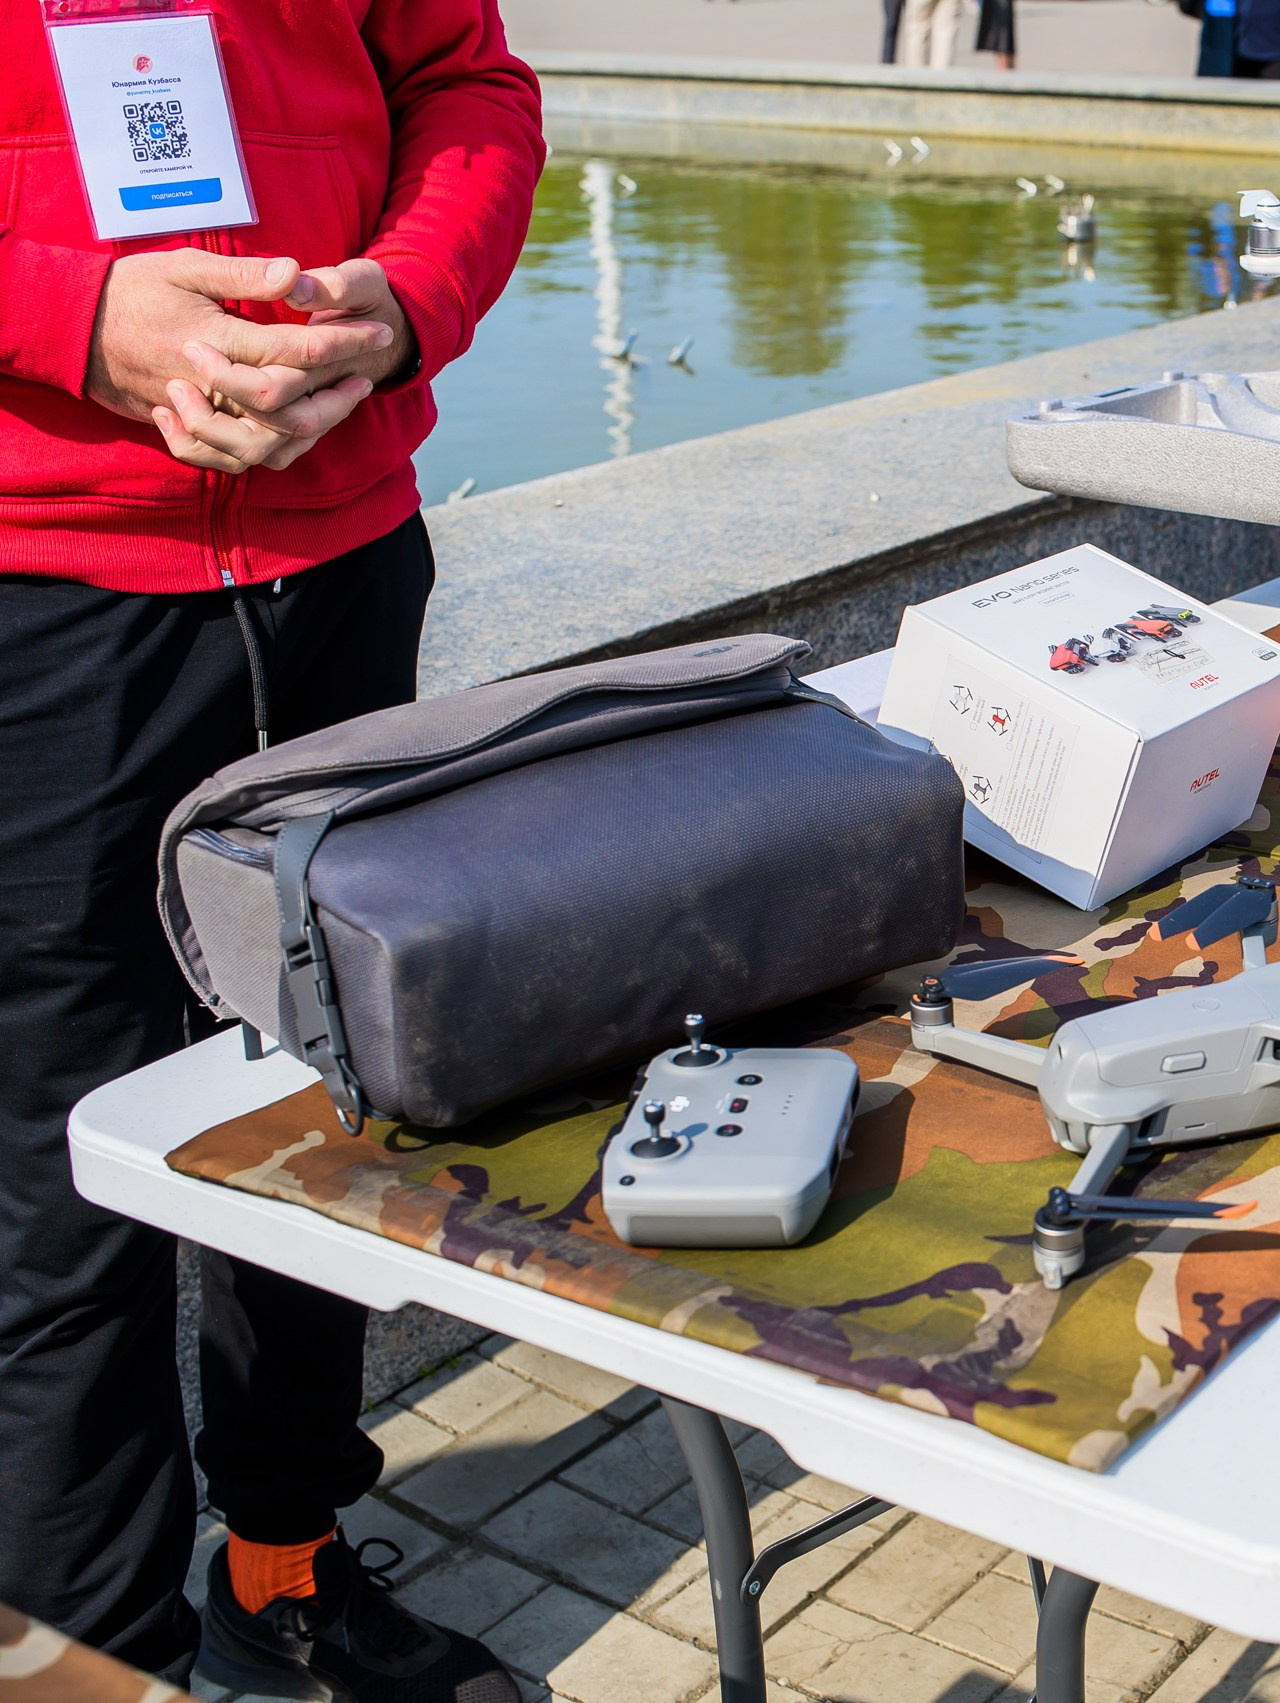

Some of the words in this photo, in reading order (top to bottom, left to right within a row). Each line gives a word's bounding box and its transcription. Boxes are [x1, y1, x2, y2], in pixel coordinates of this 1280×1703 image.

[111, 79, 147, 89] Юнармия
[148, 76, 181, 86] Кузбасса
[151, 190, 193, 200] ПОДПИСАТЬСЯ
[971, 591, 1012, 608] EVO
[1009, 579, 1045, 594] Nano
[1042, 566, 1080, 582] series
[1190, 673, 1219, 690] AUTEL
[1190, 768, 1219, 792] AUTEL
